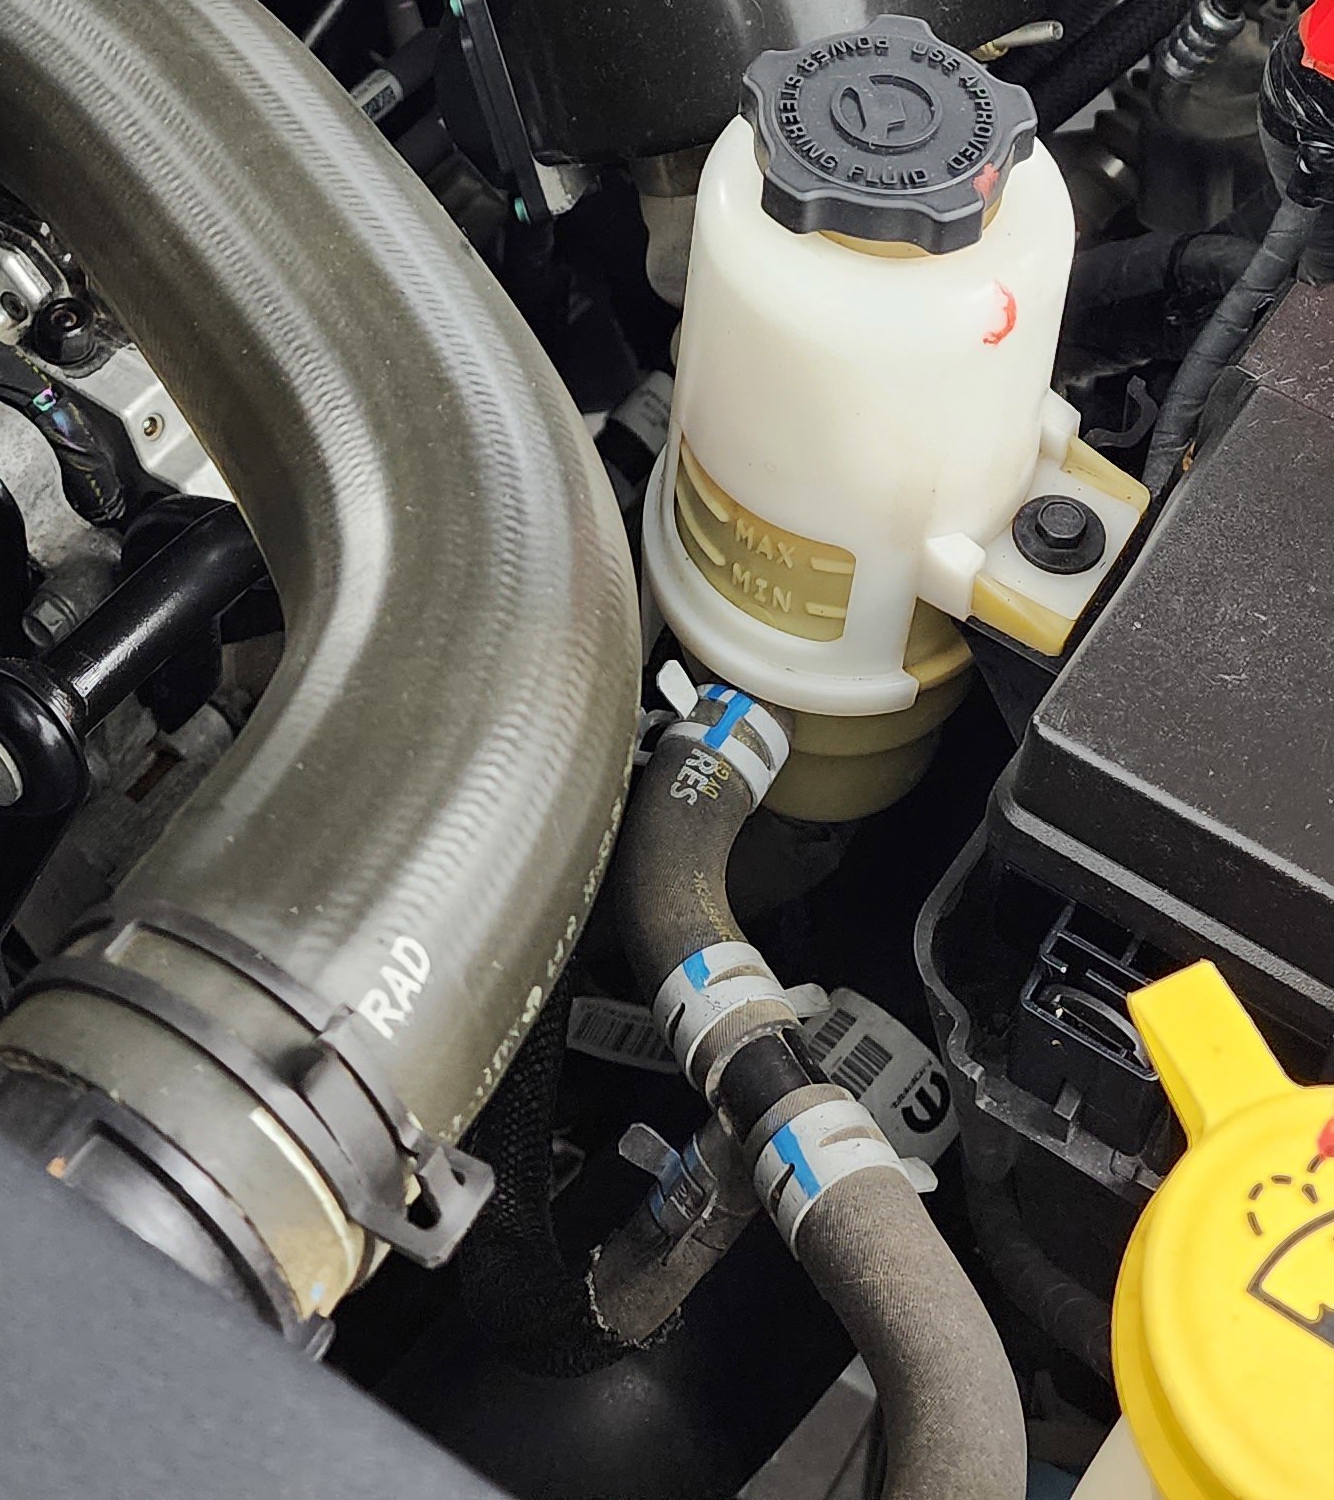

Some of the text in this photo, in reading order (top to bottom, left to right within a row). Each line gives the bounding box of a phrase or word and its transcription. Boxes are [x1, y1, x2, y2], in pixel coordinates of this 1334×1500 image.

[780, 36, 930, 186] POWER STEERING FLUID
[911, 42, 994, 171] USE APPROVED
[735, 518, 795, 569] MAX
[732, 562, 791, 613] MIN
[670, 747, 719, 806] RES
[357, 936, 431, 1039] RAD
